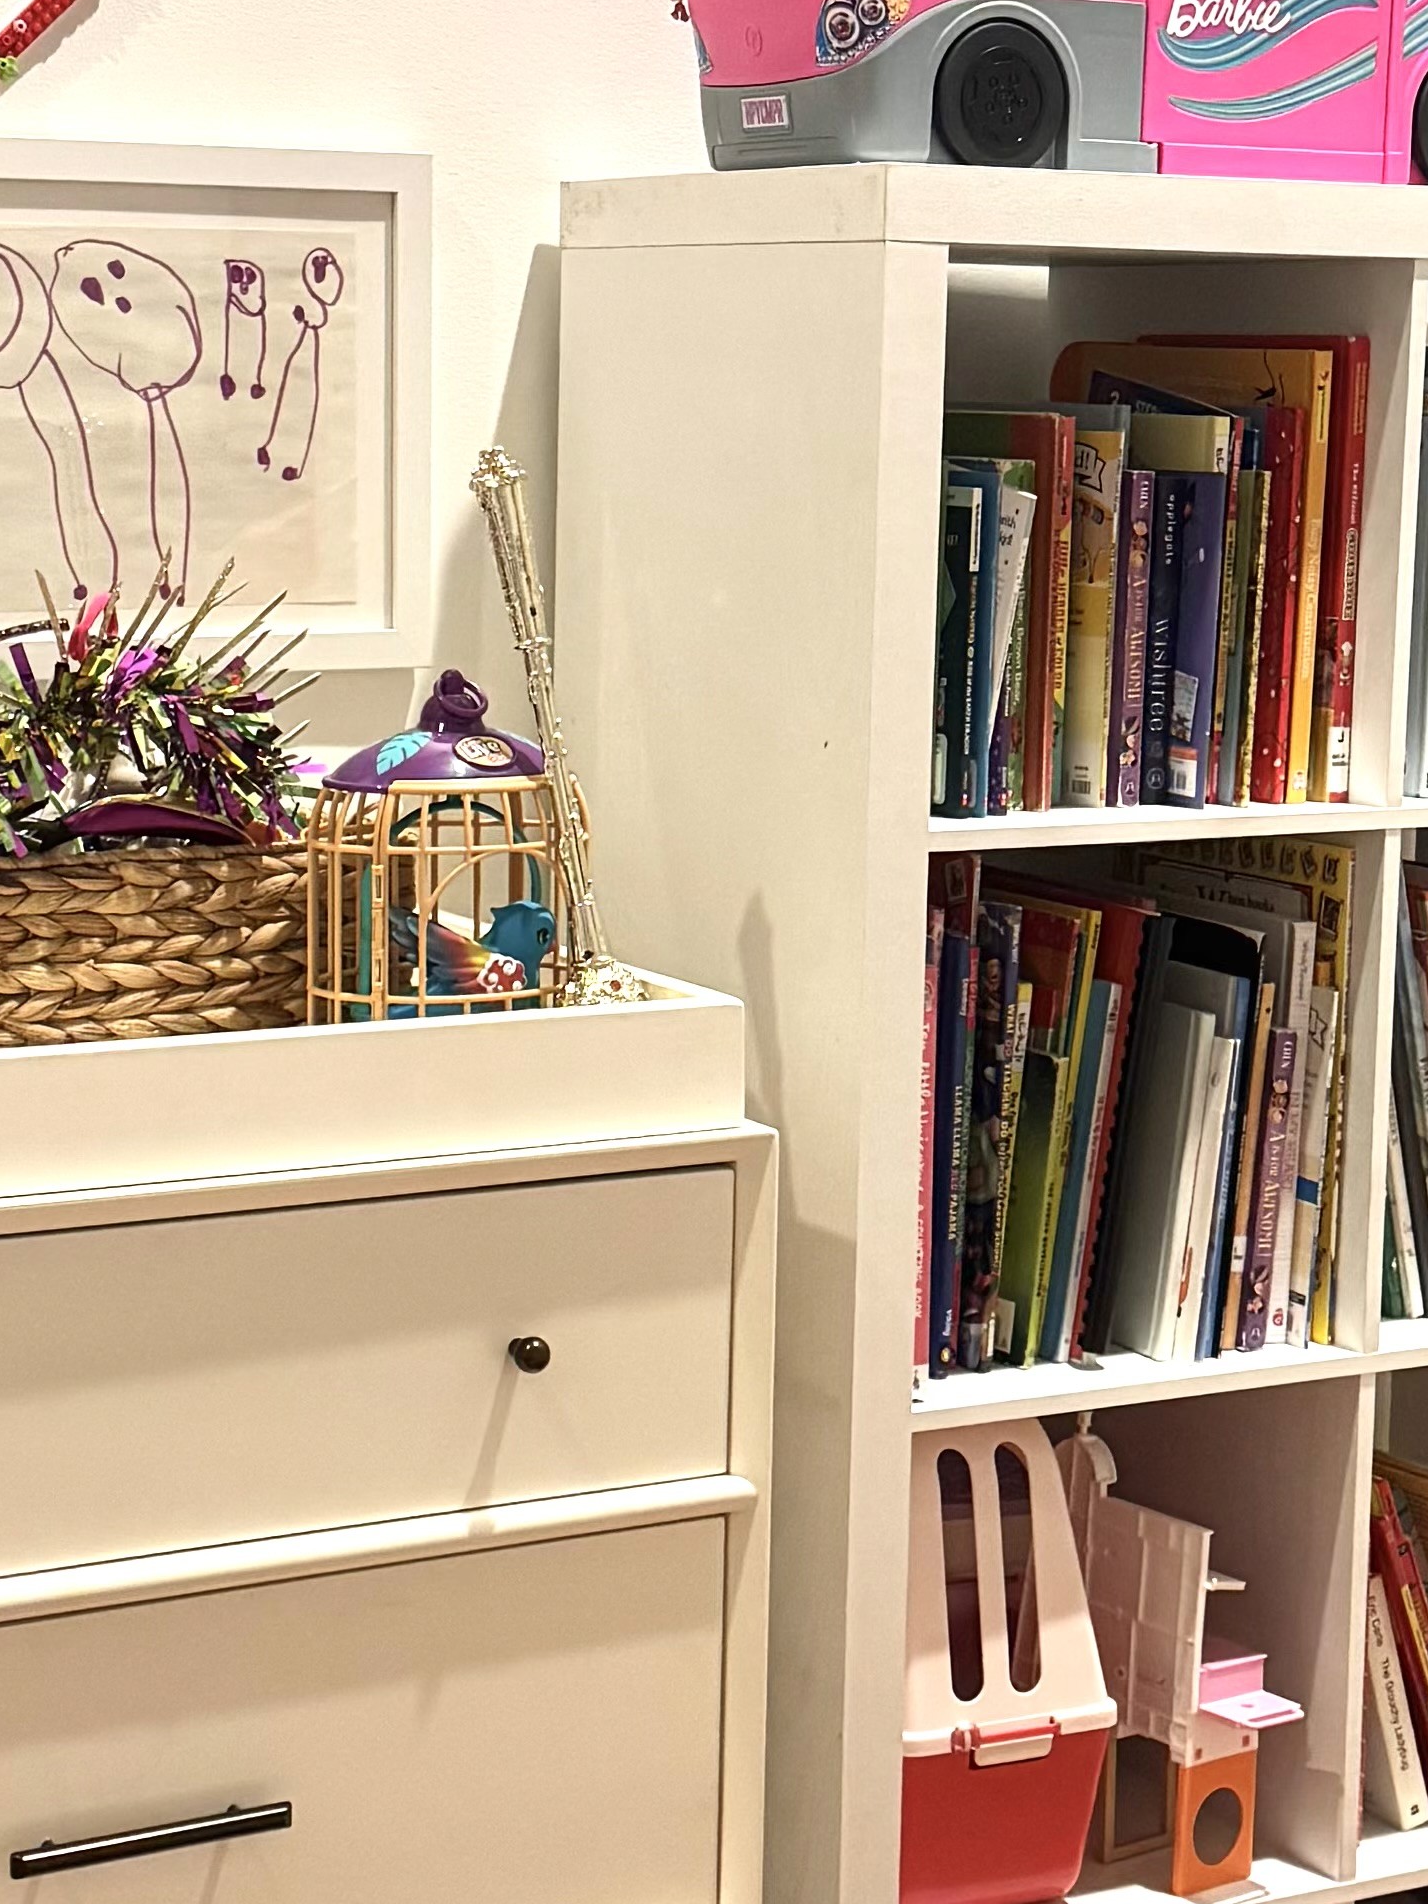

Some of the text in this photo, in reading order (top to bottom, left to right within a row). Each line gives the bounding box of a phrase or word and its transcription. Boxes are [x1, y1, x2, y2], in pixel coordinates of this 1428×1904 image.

[1165, 494, 1176, 564] applegate
[1133, 575, 1146, 587] A
[1015, 628, 1025, 668] Brown
[1012, 672, 1022, 706] Bear,
[1149, 619, 1172, 732] wishtree
[1006, 1004, 1016, 1034] WHAT
[1280, 1040, 1294, 1069] CHEN
[953, 1085, 964, 1124] LLAMA
[951, 1127, 961, 1166] LLAMA
[1269, 1130, 1286, 1142] A
[948, 1194, 958, 1240] PAJAMA
[1382, 1656, 1409, 1772] The Grouchy Ladybug
